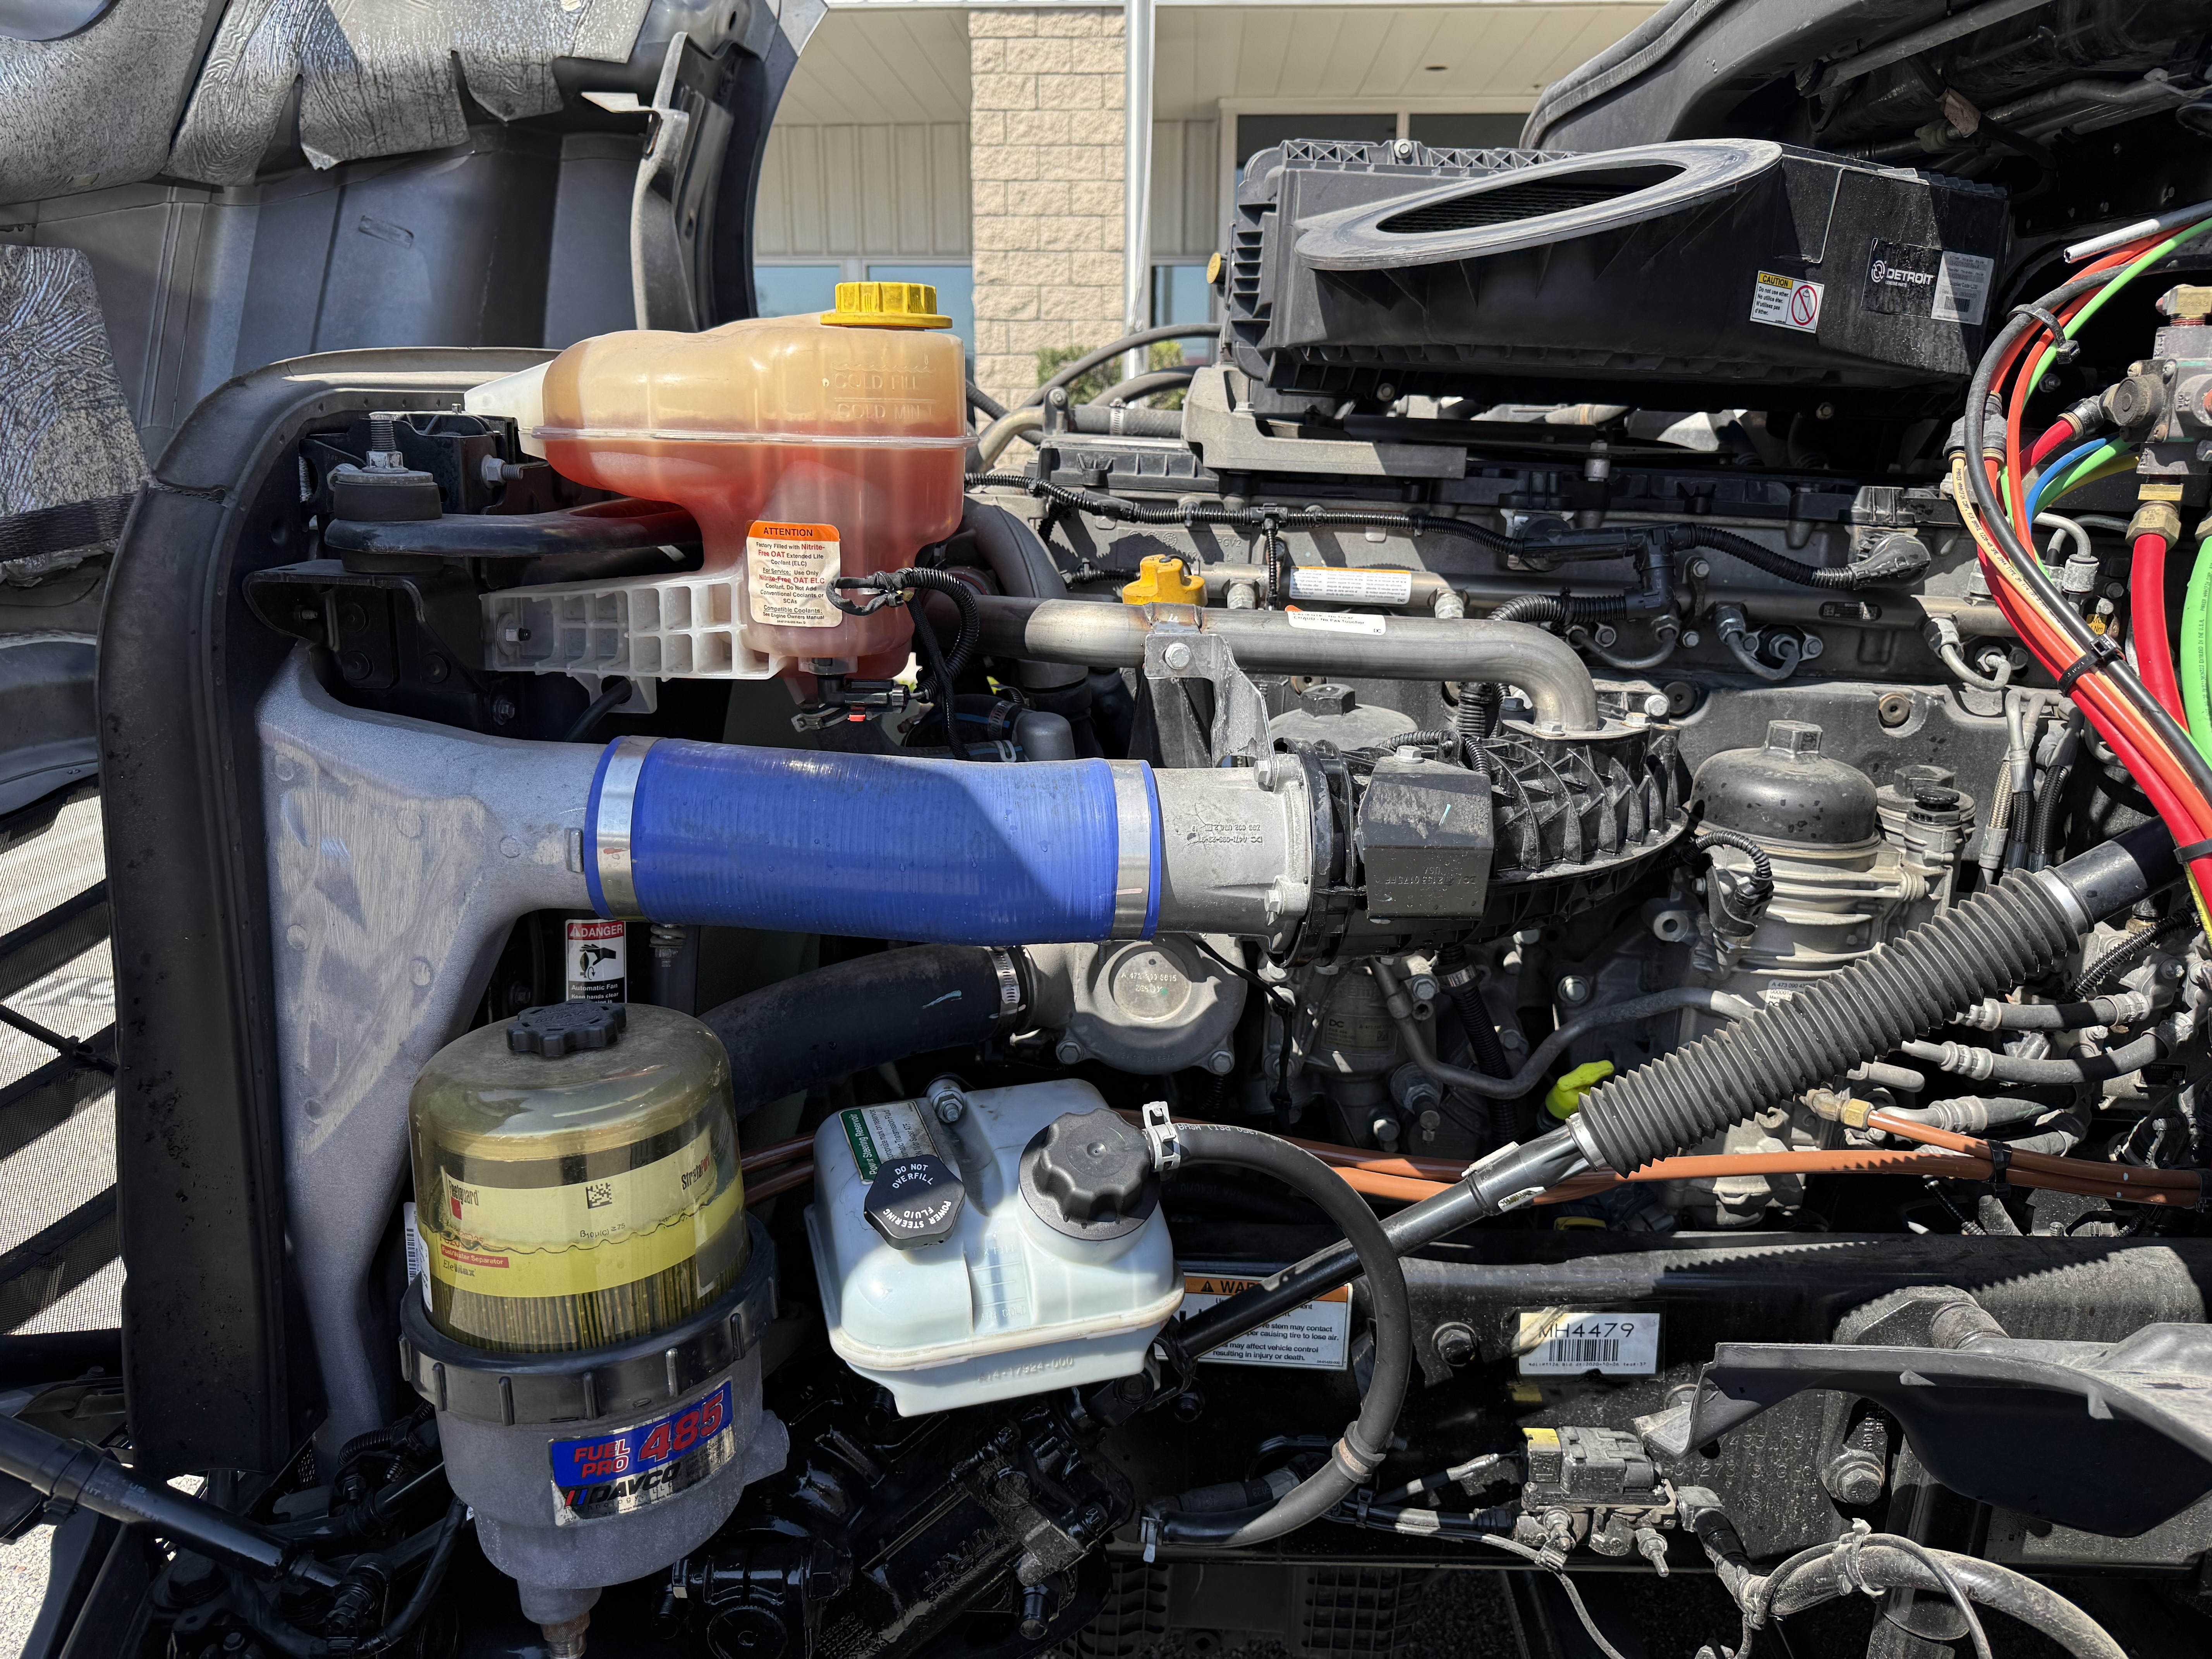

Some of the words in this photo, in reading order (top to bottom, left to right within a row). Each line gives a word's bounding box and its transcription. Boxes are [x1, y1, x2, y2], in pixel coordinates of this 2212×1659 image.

[1762, 275, 1789, 287] CAUTION
[1886, 268, 1935, 285] DETROIT
[834, 373, 883, 390] COLD
[838, 403, 886, 419] COLD
[894, 404, 919, 420] MIN
[763, 527, 813, 536] ATTENTION
[759, 574, 791, 583] Nitrite-Free
[1423, 866, 1440, 875] USA
[581, 924, 623, 937] DANGER
[1329, 1019, 1344, 1028] DC
[852, 1114, 864, 1137] Reservoir
[860, 1137, 869, 1158] Steering
[866, 1159, 878, 1175] Power
[895, 1165, 907, 1176] DO
[910, 1163, 928, 1172] NOT
[892, 1172, 934, 1189] OVERFILL
[883, 1208, 924, 1229] STEERING
[903, 1206, 934, 1219] FLUID
[928, 1200, 951, 1224] POWER
[441, 1247, 470, 1261] Fuel/Water
[471, 1255, 504, 1265] Separator
[1260, 1331, 1288, 1339] causing
[1539, 1322, 1634, 1338] MH4479
[1212, 1349, 1243, 1358] resulting
[1253, 1351, 1272, 1360] injury
[1267, 1343, 1292, 1352] vehicle
[637, 1389, 724, 1462] 485
[574, 1439, 631, 1463] FUEL
[581, 1455, 630, 1479] PRO
[587, 1462, 681, 1504] DAVCO
